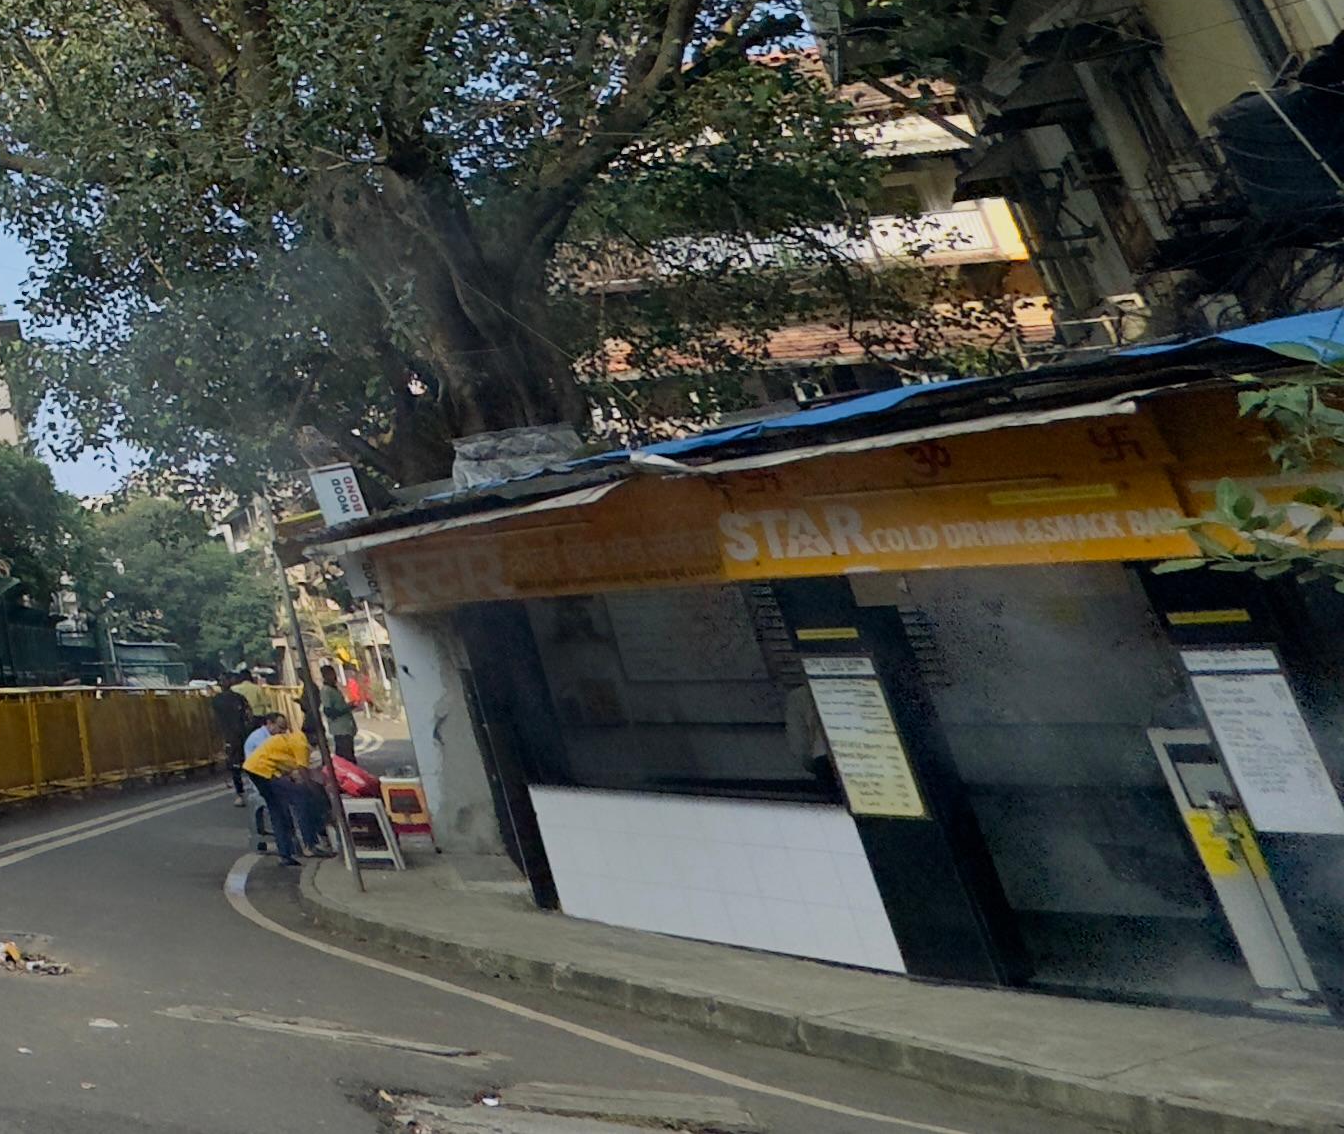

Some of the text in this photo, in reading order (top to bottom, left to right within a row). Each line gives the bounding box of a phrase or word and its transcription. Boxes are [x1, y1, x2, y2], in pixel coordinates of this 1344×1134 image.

[330, 477, 351, 514] WOOD
[343, 475, 364, 513] BOND
[719, 504, 875, 562] STAR
[871, 524, 939, 554] COLD
